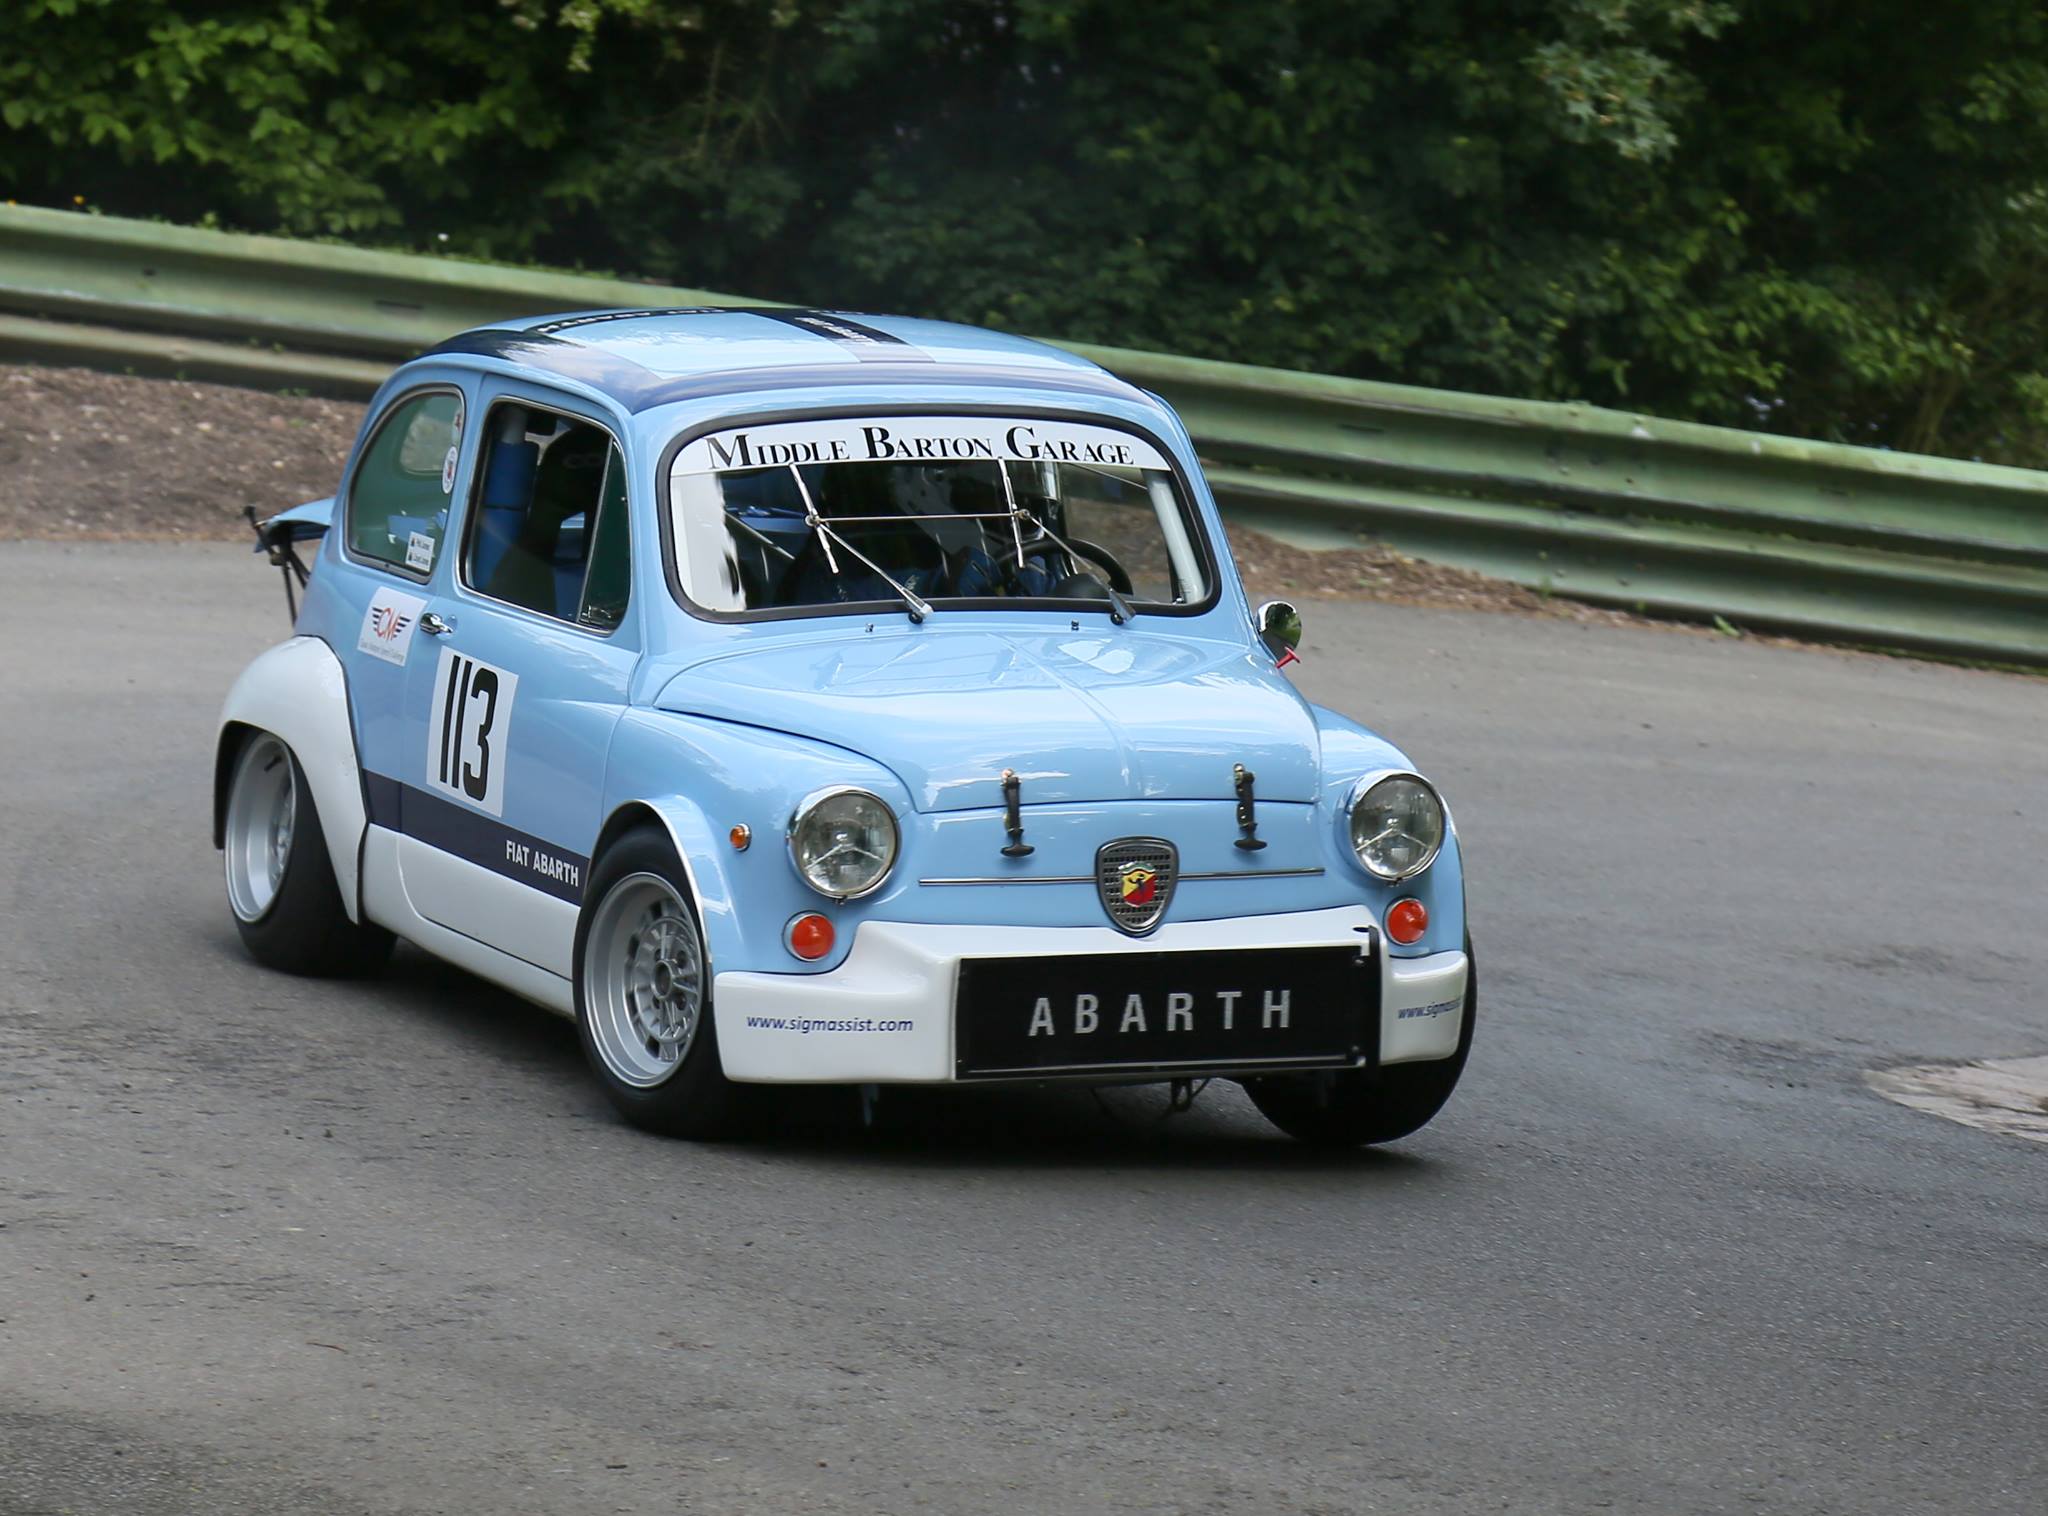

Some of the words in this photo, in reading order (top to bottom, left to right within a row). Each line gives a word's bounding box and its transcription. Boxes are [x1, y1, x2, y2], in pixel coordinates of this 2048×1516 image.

[704, 433, 850, 470] MIDDLE
[860, 426, 993, 459] BARTON
[1006, 426, 1134, 465] GARAGE
[440, 655, 499, 801] 113
[506, 839, 530, 867] FIAT
[533, 851, 579, 887] ABARTH
[746, 1006, 914, 1034] www.sigmassist.com
[1028, 990, 1291, 1036] ABARTH
